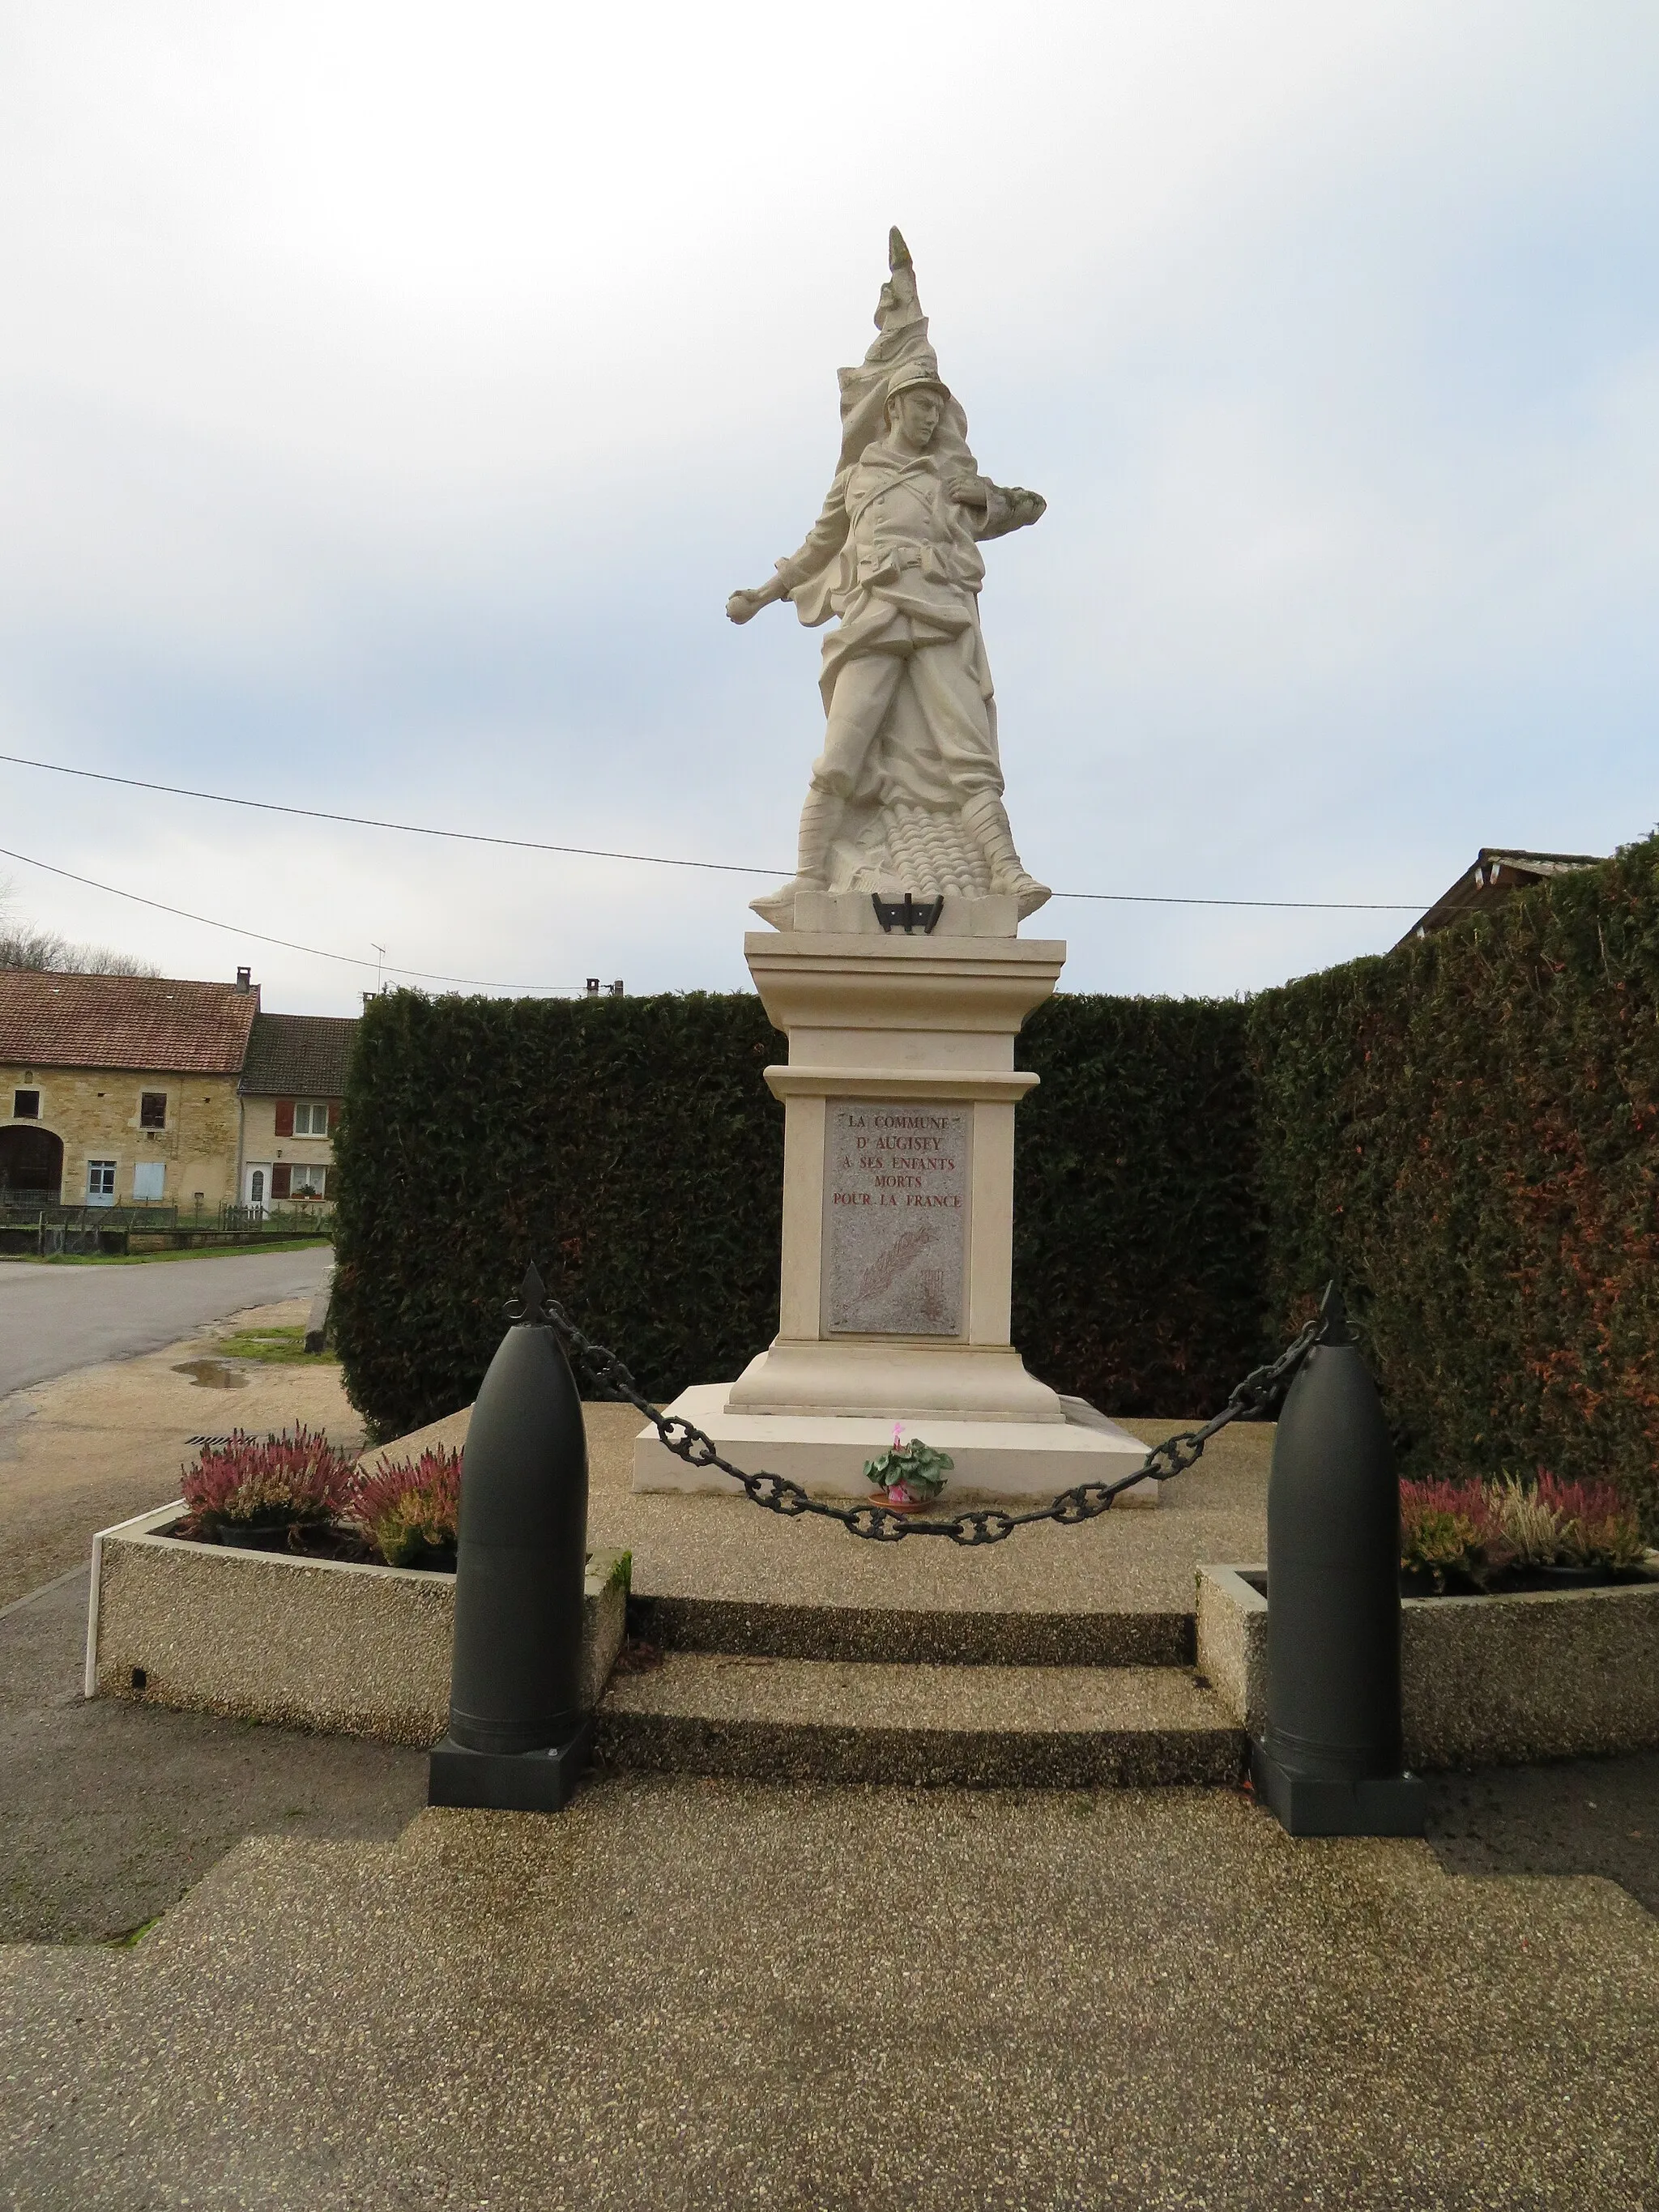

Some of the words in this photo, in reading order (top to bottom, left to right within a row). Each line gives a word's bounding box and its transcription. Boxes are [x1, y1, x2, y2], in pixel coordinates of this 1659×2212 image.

[849, 1115, 864, 1127] LA
[875, 1116, 949, 1128] COMMUNE
[876, 1136, 942, 1150] AUGISEY
[860, 1157, 883, 1169] SES
[893, 1157, 955, 1170] ENFANTS
[875, 1176, 922, 1187] MORTS
[834, 1193, 871, 1205] POUR
[881, 1195, 897, 1205] LA
[906, 1196, 962, 1208] FRANCE
